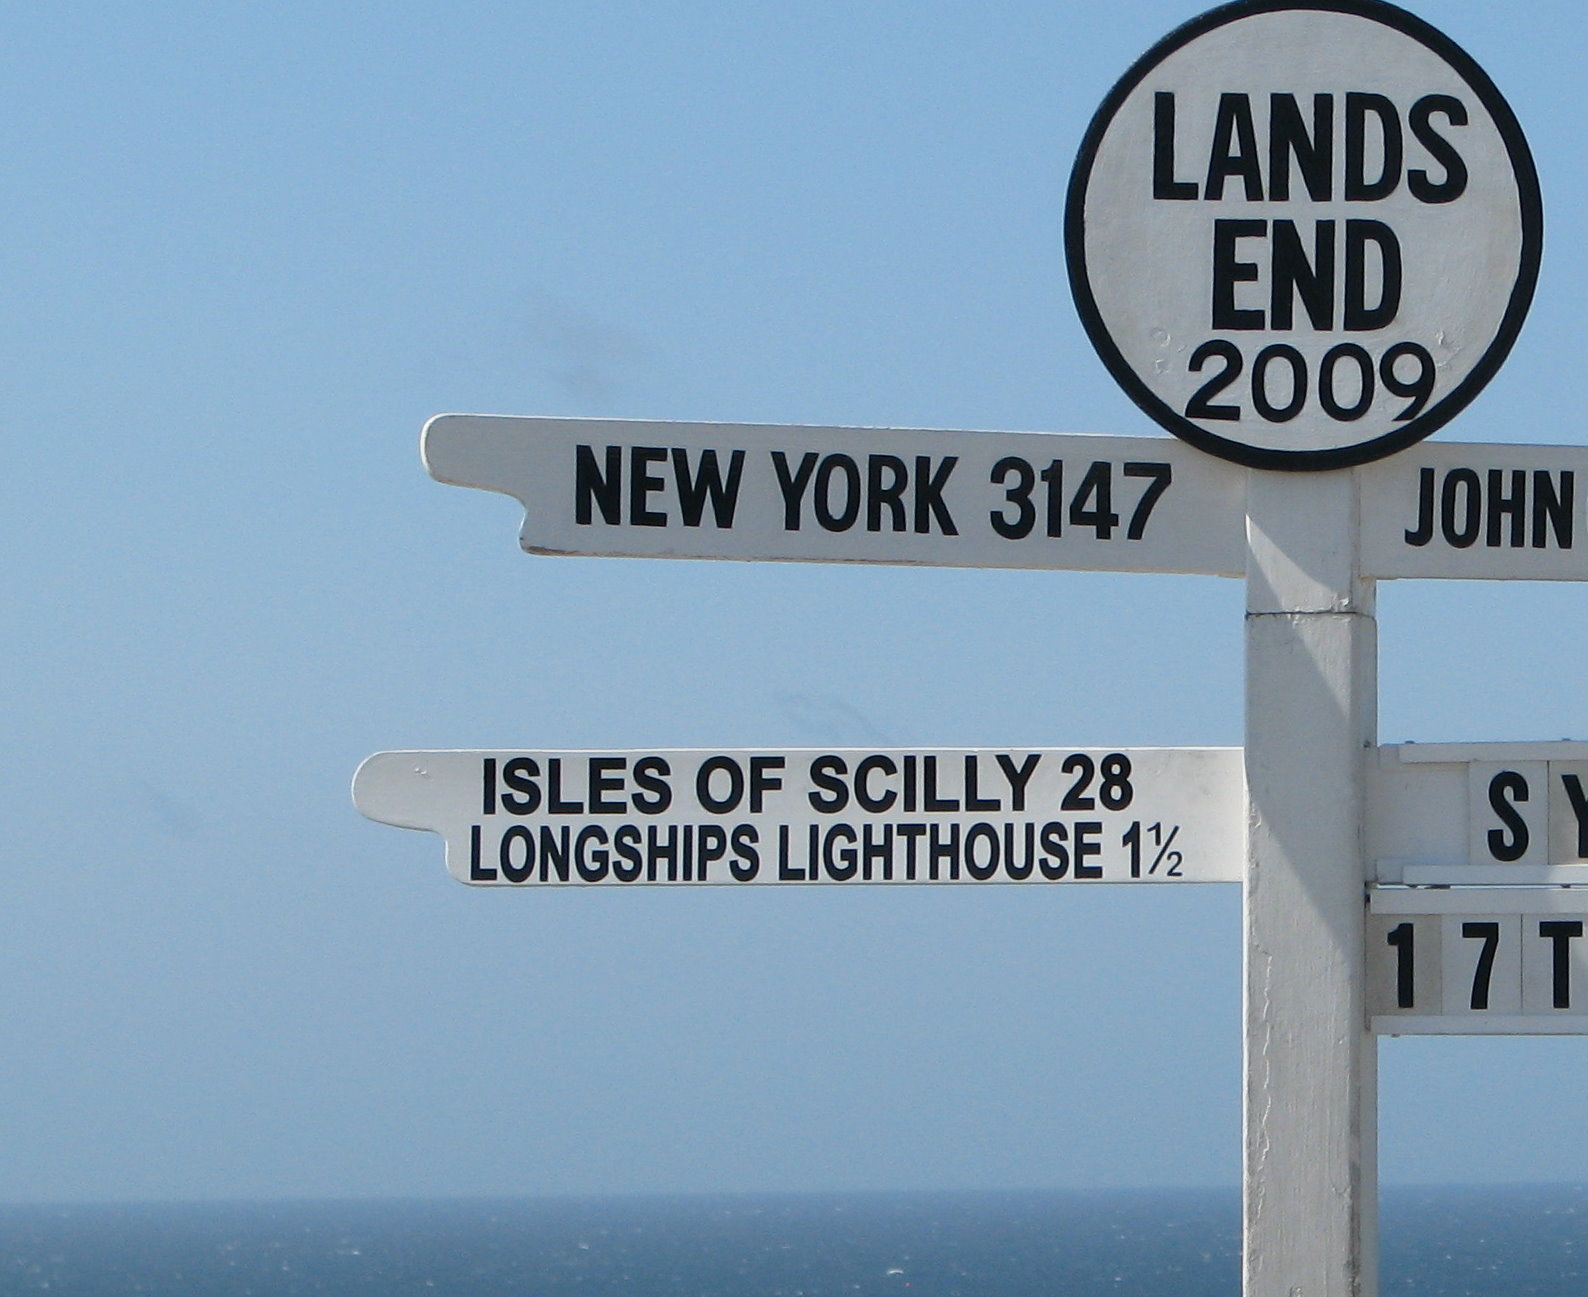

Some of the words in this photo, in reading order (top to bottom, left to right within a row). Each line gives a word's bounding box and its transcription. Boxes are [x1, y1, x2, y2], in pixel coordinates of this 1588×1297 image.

[1152, 91, 1469, 204] LANDS
[1211, 218, 1403, 332] END
[1184, 339, 1437, 424] 2009
[575, 444, 747, 529] NEW
[770, 450, 960, 536] YORK
[989, 456, 1173, 541] 3147
[1404, 466, 1575, 550] JOHN
[483, 756, 672, 816] ISLES
[696, 755, 786, 815] OF
[808, 753, 1042, 815] SCILLY
[1060, 752, 1134, 812] 28
[470, 823, 760, 883] LONGSHIPS
[778, 821, 1103, 882] LIGHTHOUSE
